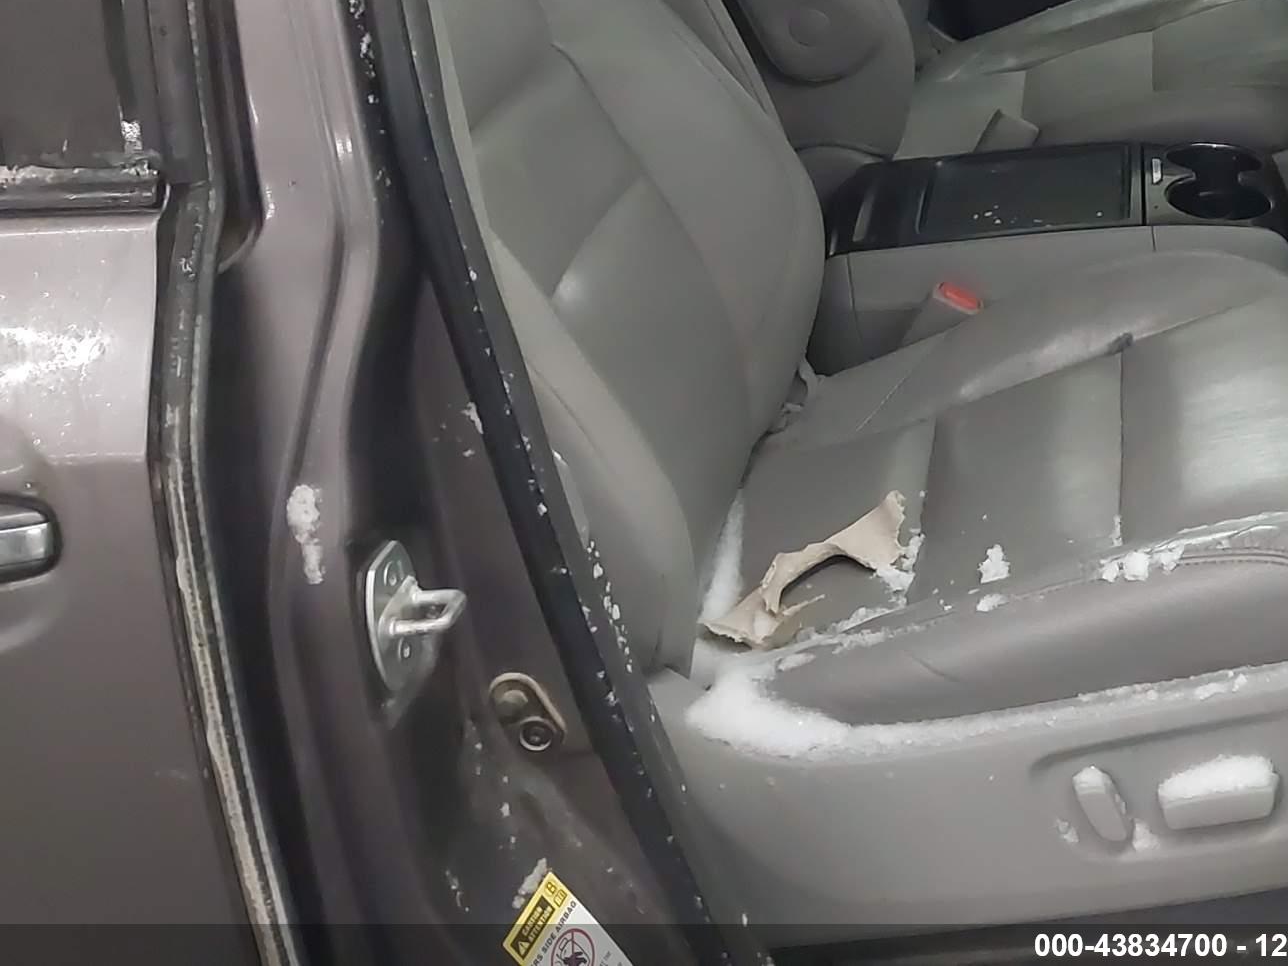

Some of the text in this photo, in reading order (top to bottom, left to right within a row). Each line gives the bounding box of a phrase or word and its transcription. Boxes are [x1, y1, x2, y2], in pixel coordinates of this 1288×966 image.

[521, 906, 543, 937] CAUTION
[528, 905, 553, 942] ATTENTION
[530, 900, 577, 966] RS SIDE AIRBAG
